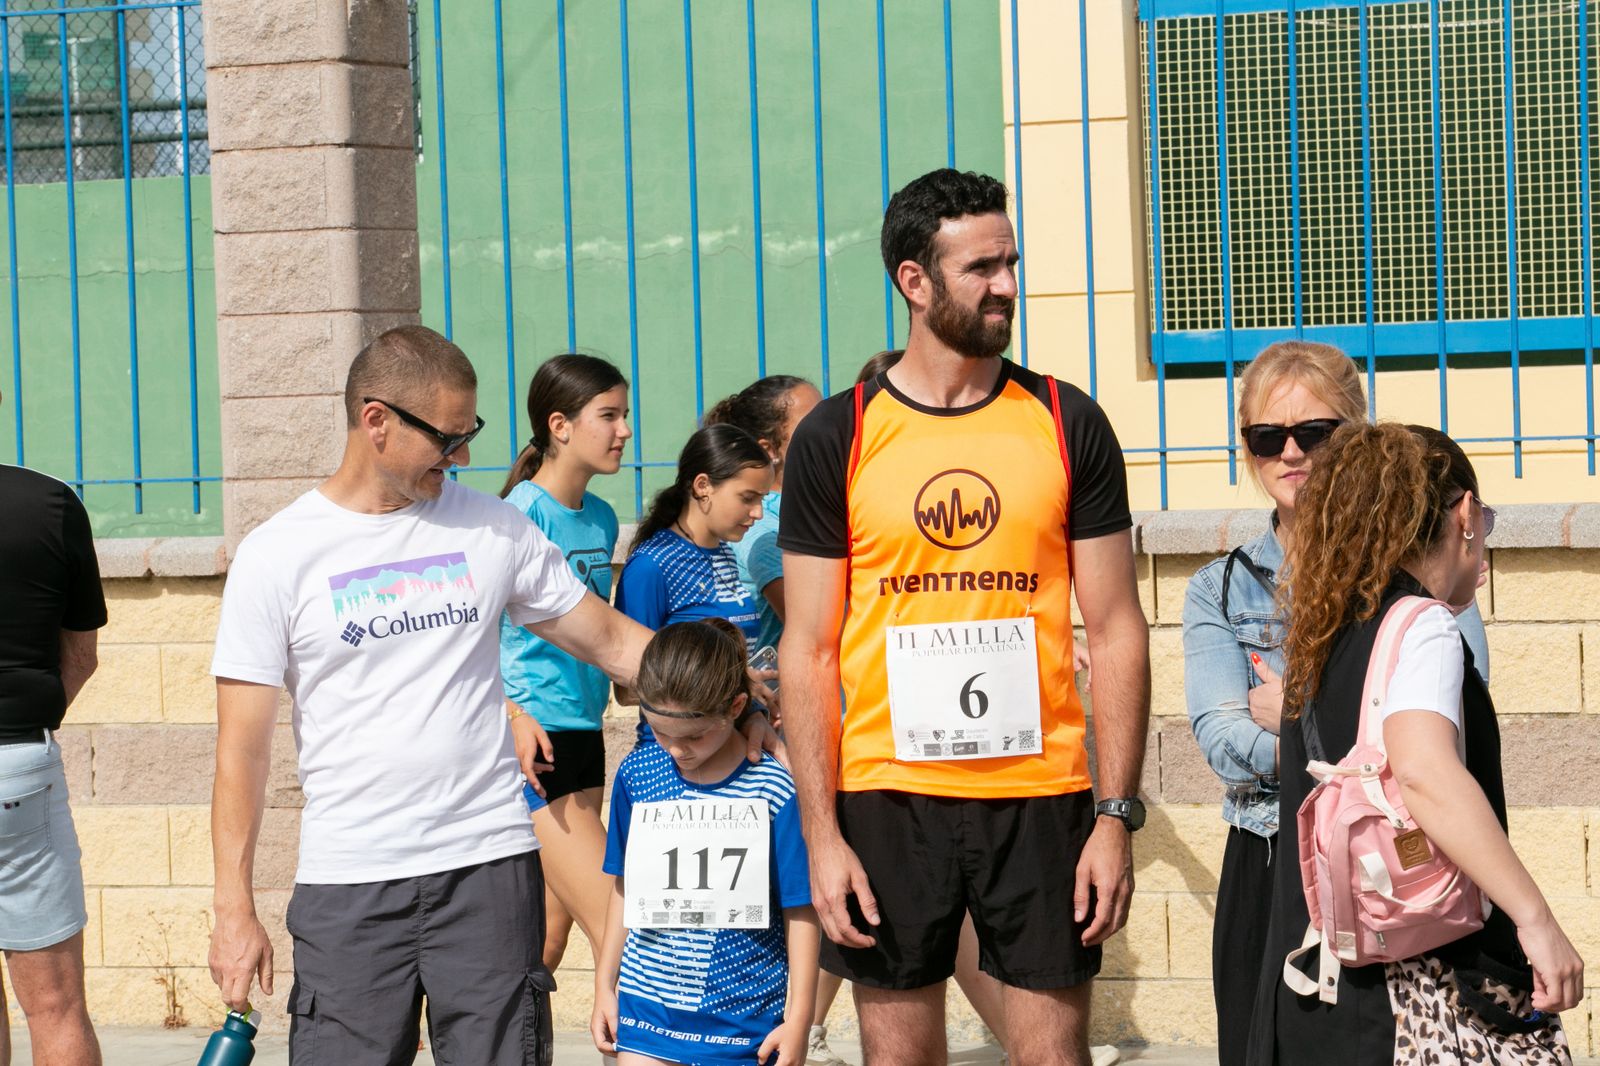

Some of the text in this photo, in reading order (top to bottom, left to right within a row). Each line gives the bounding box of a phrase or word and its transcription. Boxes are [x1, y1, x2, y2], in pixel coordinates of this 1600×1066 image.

[368, 602, 480, 639] Columbia
[897, 624, 1025, 650] II MILLA
[911, 647, 961, 658] POPULAR
[959, 671, 989, 719] 6
[671, 804, 759, 822] MILLA
[661, 846, 749, 891] 117
[637, 1020, 702, 1042] ATLETISMO
[704, 1034, 751, 1046] LINENSE
